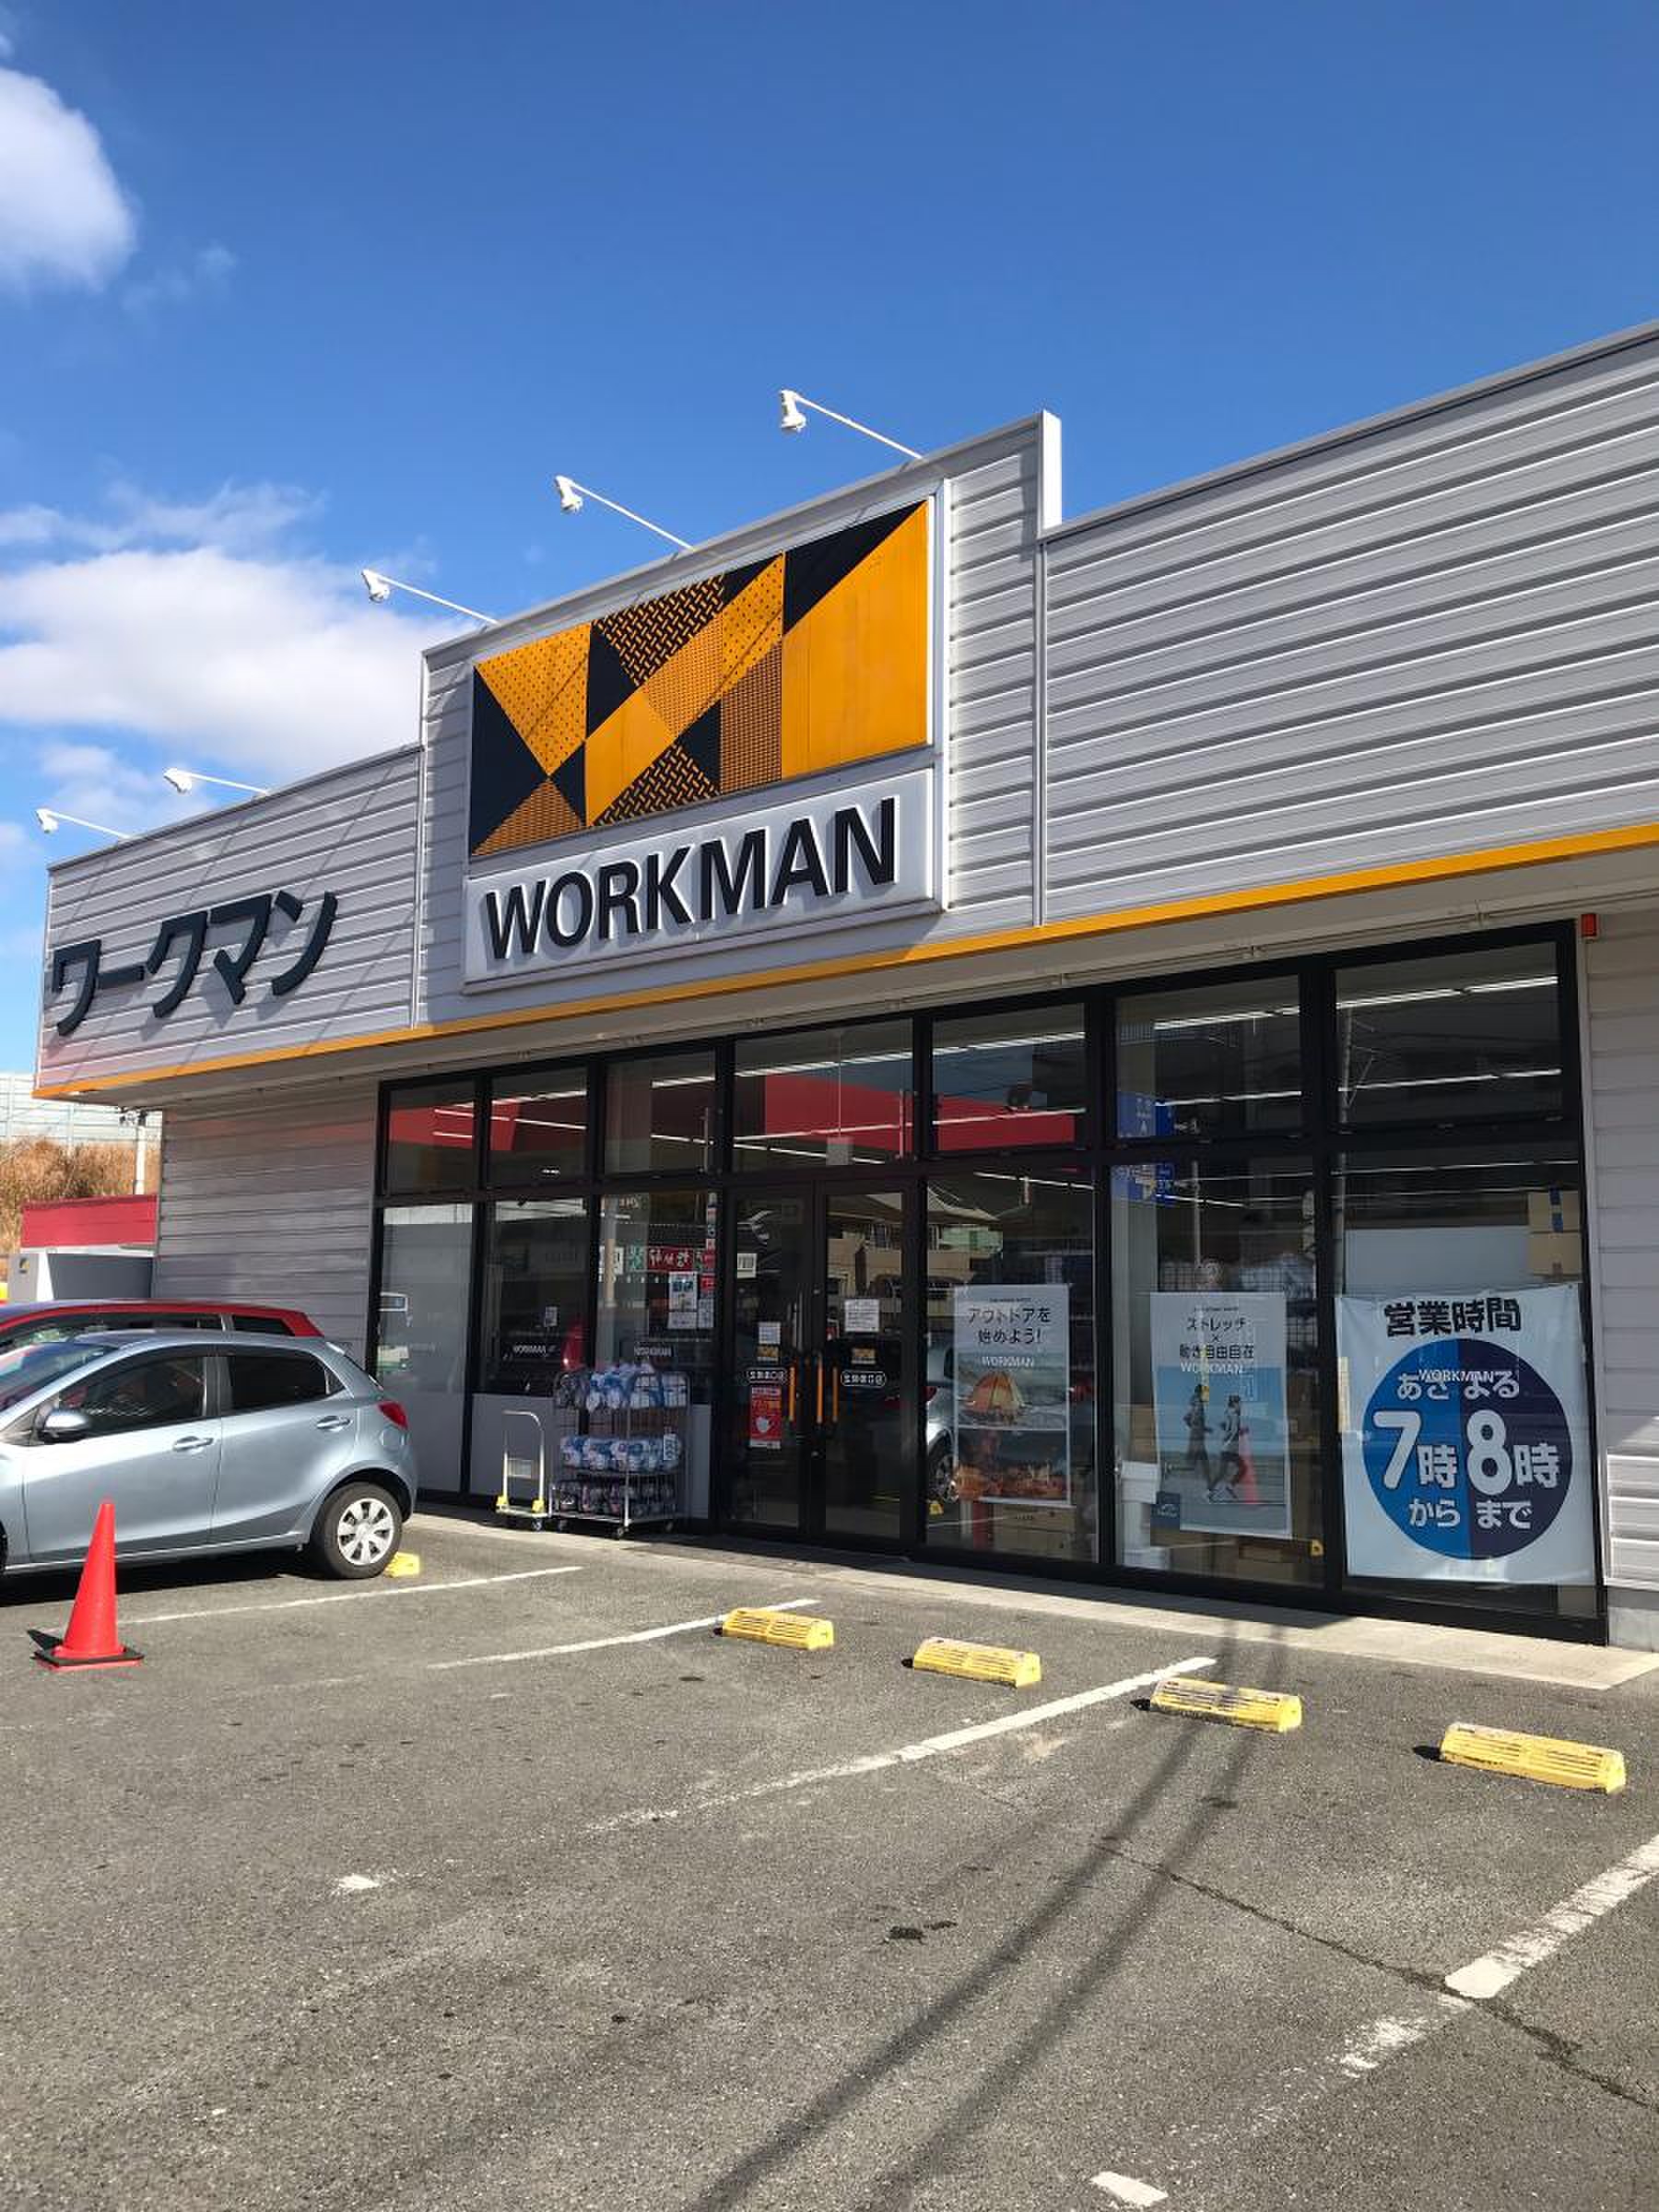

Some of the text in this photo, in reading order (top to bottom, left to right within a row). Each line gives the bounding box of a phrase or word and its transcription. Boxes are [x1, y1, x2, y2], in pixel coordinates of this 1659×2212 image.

[485, 796, 900, 960] WORKMAN
[52, 889, 338, 1036] ワークマン
[968, 1307, 1052, 1324] アウトドアを
[1186, 1316, 1247, 1332] ストレッチ
[1384, 1297, 1522, 1336] 営業時間
[1418, 1369, 1495, 1382] WORKMAN
[1372, 1410, 1457, 1489] 7時
[1466, 1409, 1560, 1496] 8時
[1408, 1498, 1461, 1528] から
[1476, 1500, 1534, 1530] まで
